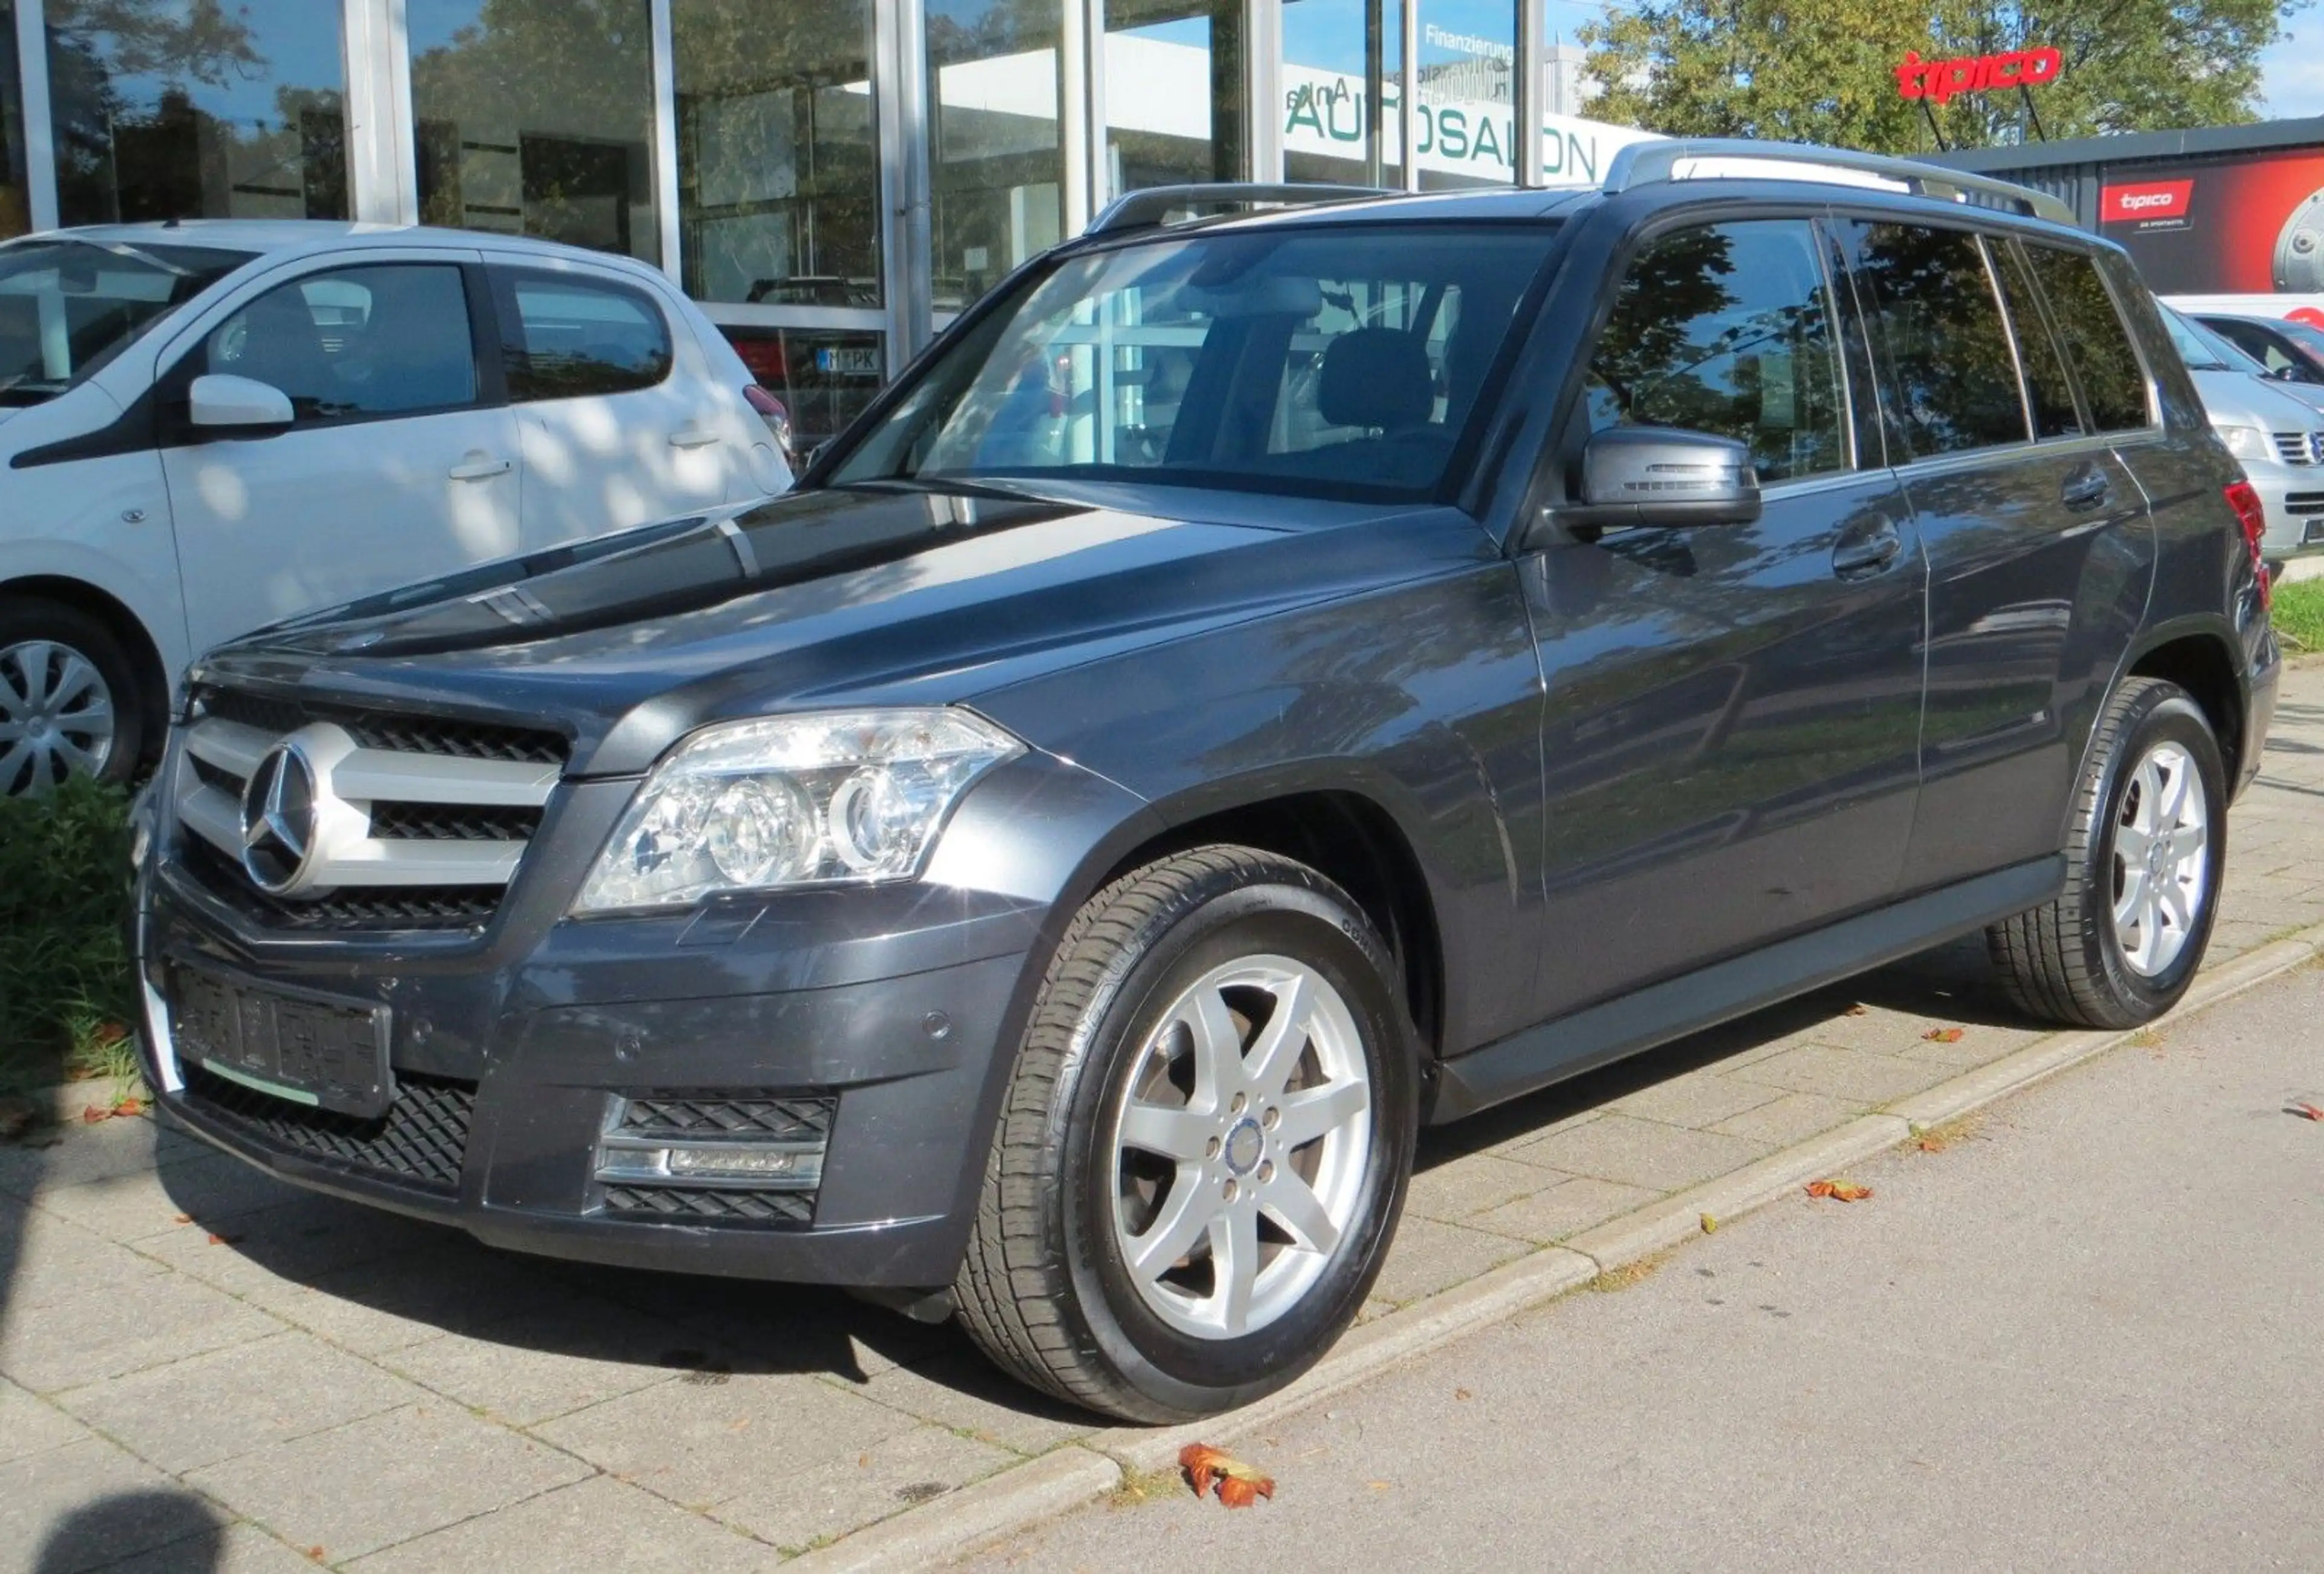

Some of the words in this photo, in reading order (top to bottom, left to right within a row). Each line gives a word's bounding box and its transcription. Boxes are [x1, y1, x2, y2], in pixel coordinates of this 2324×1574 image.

[1426, 24, 1514, 67] Finanzierung
[1896, 46, 2061, 106] tipico
[2119, 193, 2173, 210] tipico
